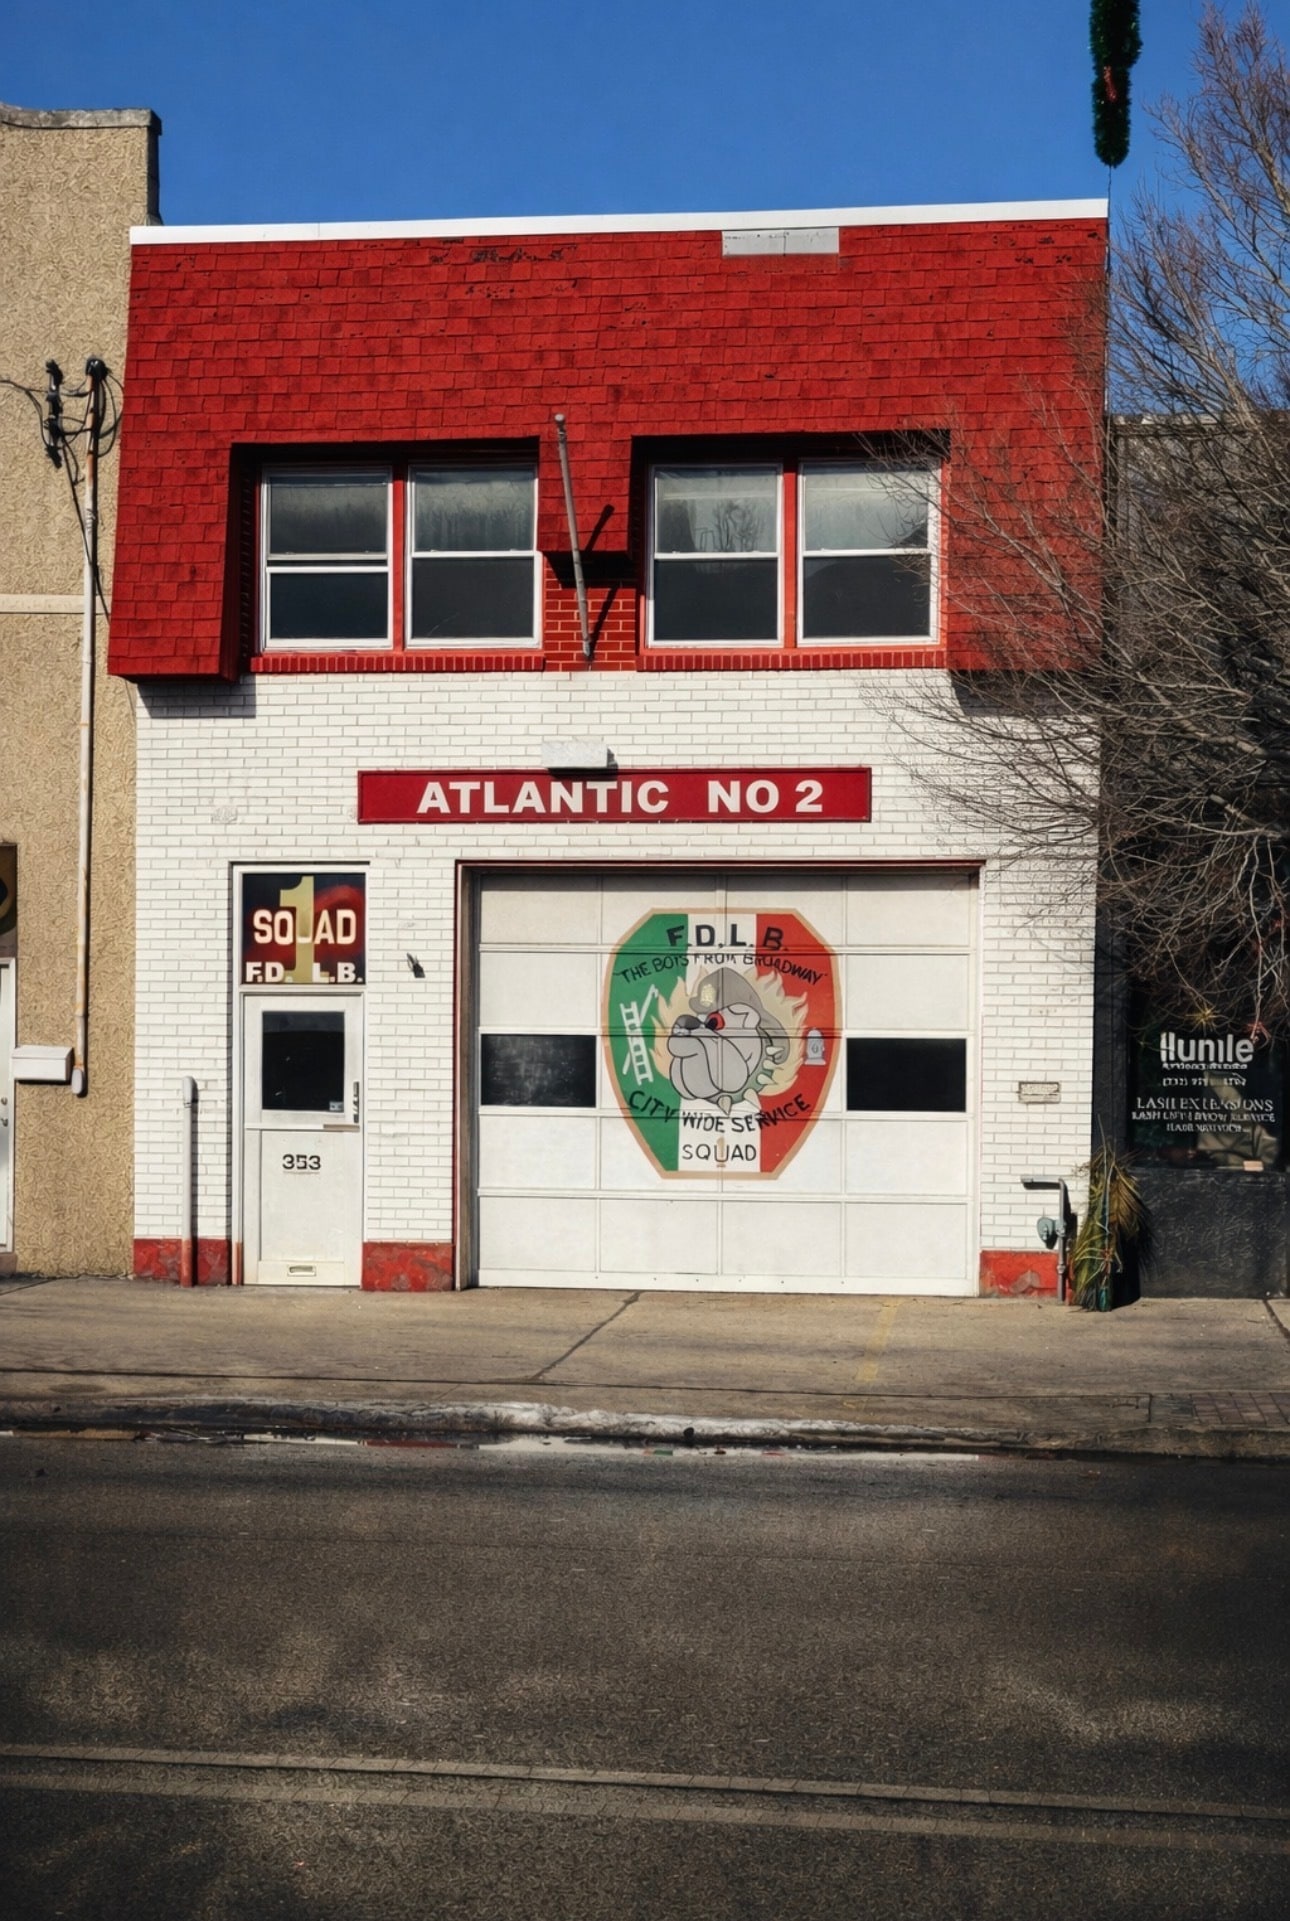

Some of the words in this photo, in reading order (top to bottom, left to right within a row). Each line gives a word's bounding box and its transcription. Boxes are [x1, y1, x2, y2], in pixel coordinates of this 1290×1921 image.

[417, 780, 669, 814] ATLANTIC
[707, 780, 779, 814] NO
[795, 779, 823, 813] 2
[279, 875, 315, 984] 1
[628, 1090, 680, 1123] CITY
[682, 1111, 726, 1133] WIDE
[731, 1093, 811, 1133] SERVICE
[282, 1153, 321, 1170] 353
[681, 1143, 757, 1163] SQUAD
